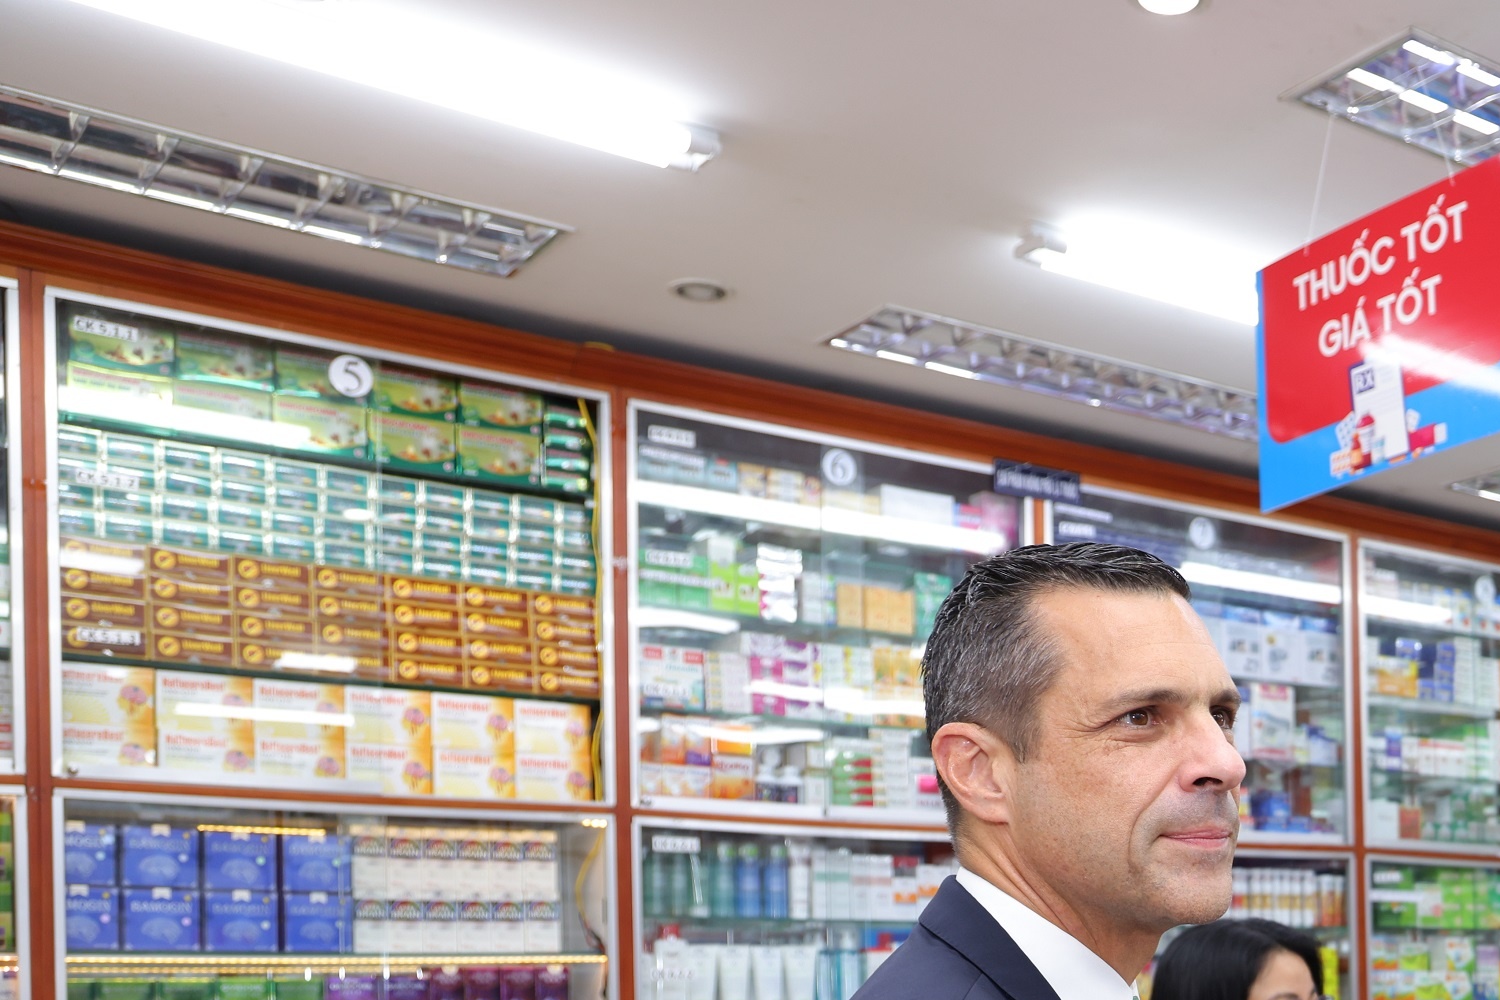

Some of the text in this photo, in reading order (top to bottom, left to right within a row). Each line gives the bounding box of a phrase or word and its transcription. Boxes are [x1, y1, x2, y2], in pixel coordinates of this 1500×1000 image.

[1293, 193, 1468, 311] THUỐC TỐT
[1318, 267, 1442, 357] GIÁ TỐT
[341, 358, 362, 394] 5
[830, 450, 848, 482] 6
